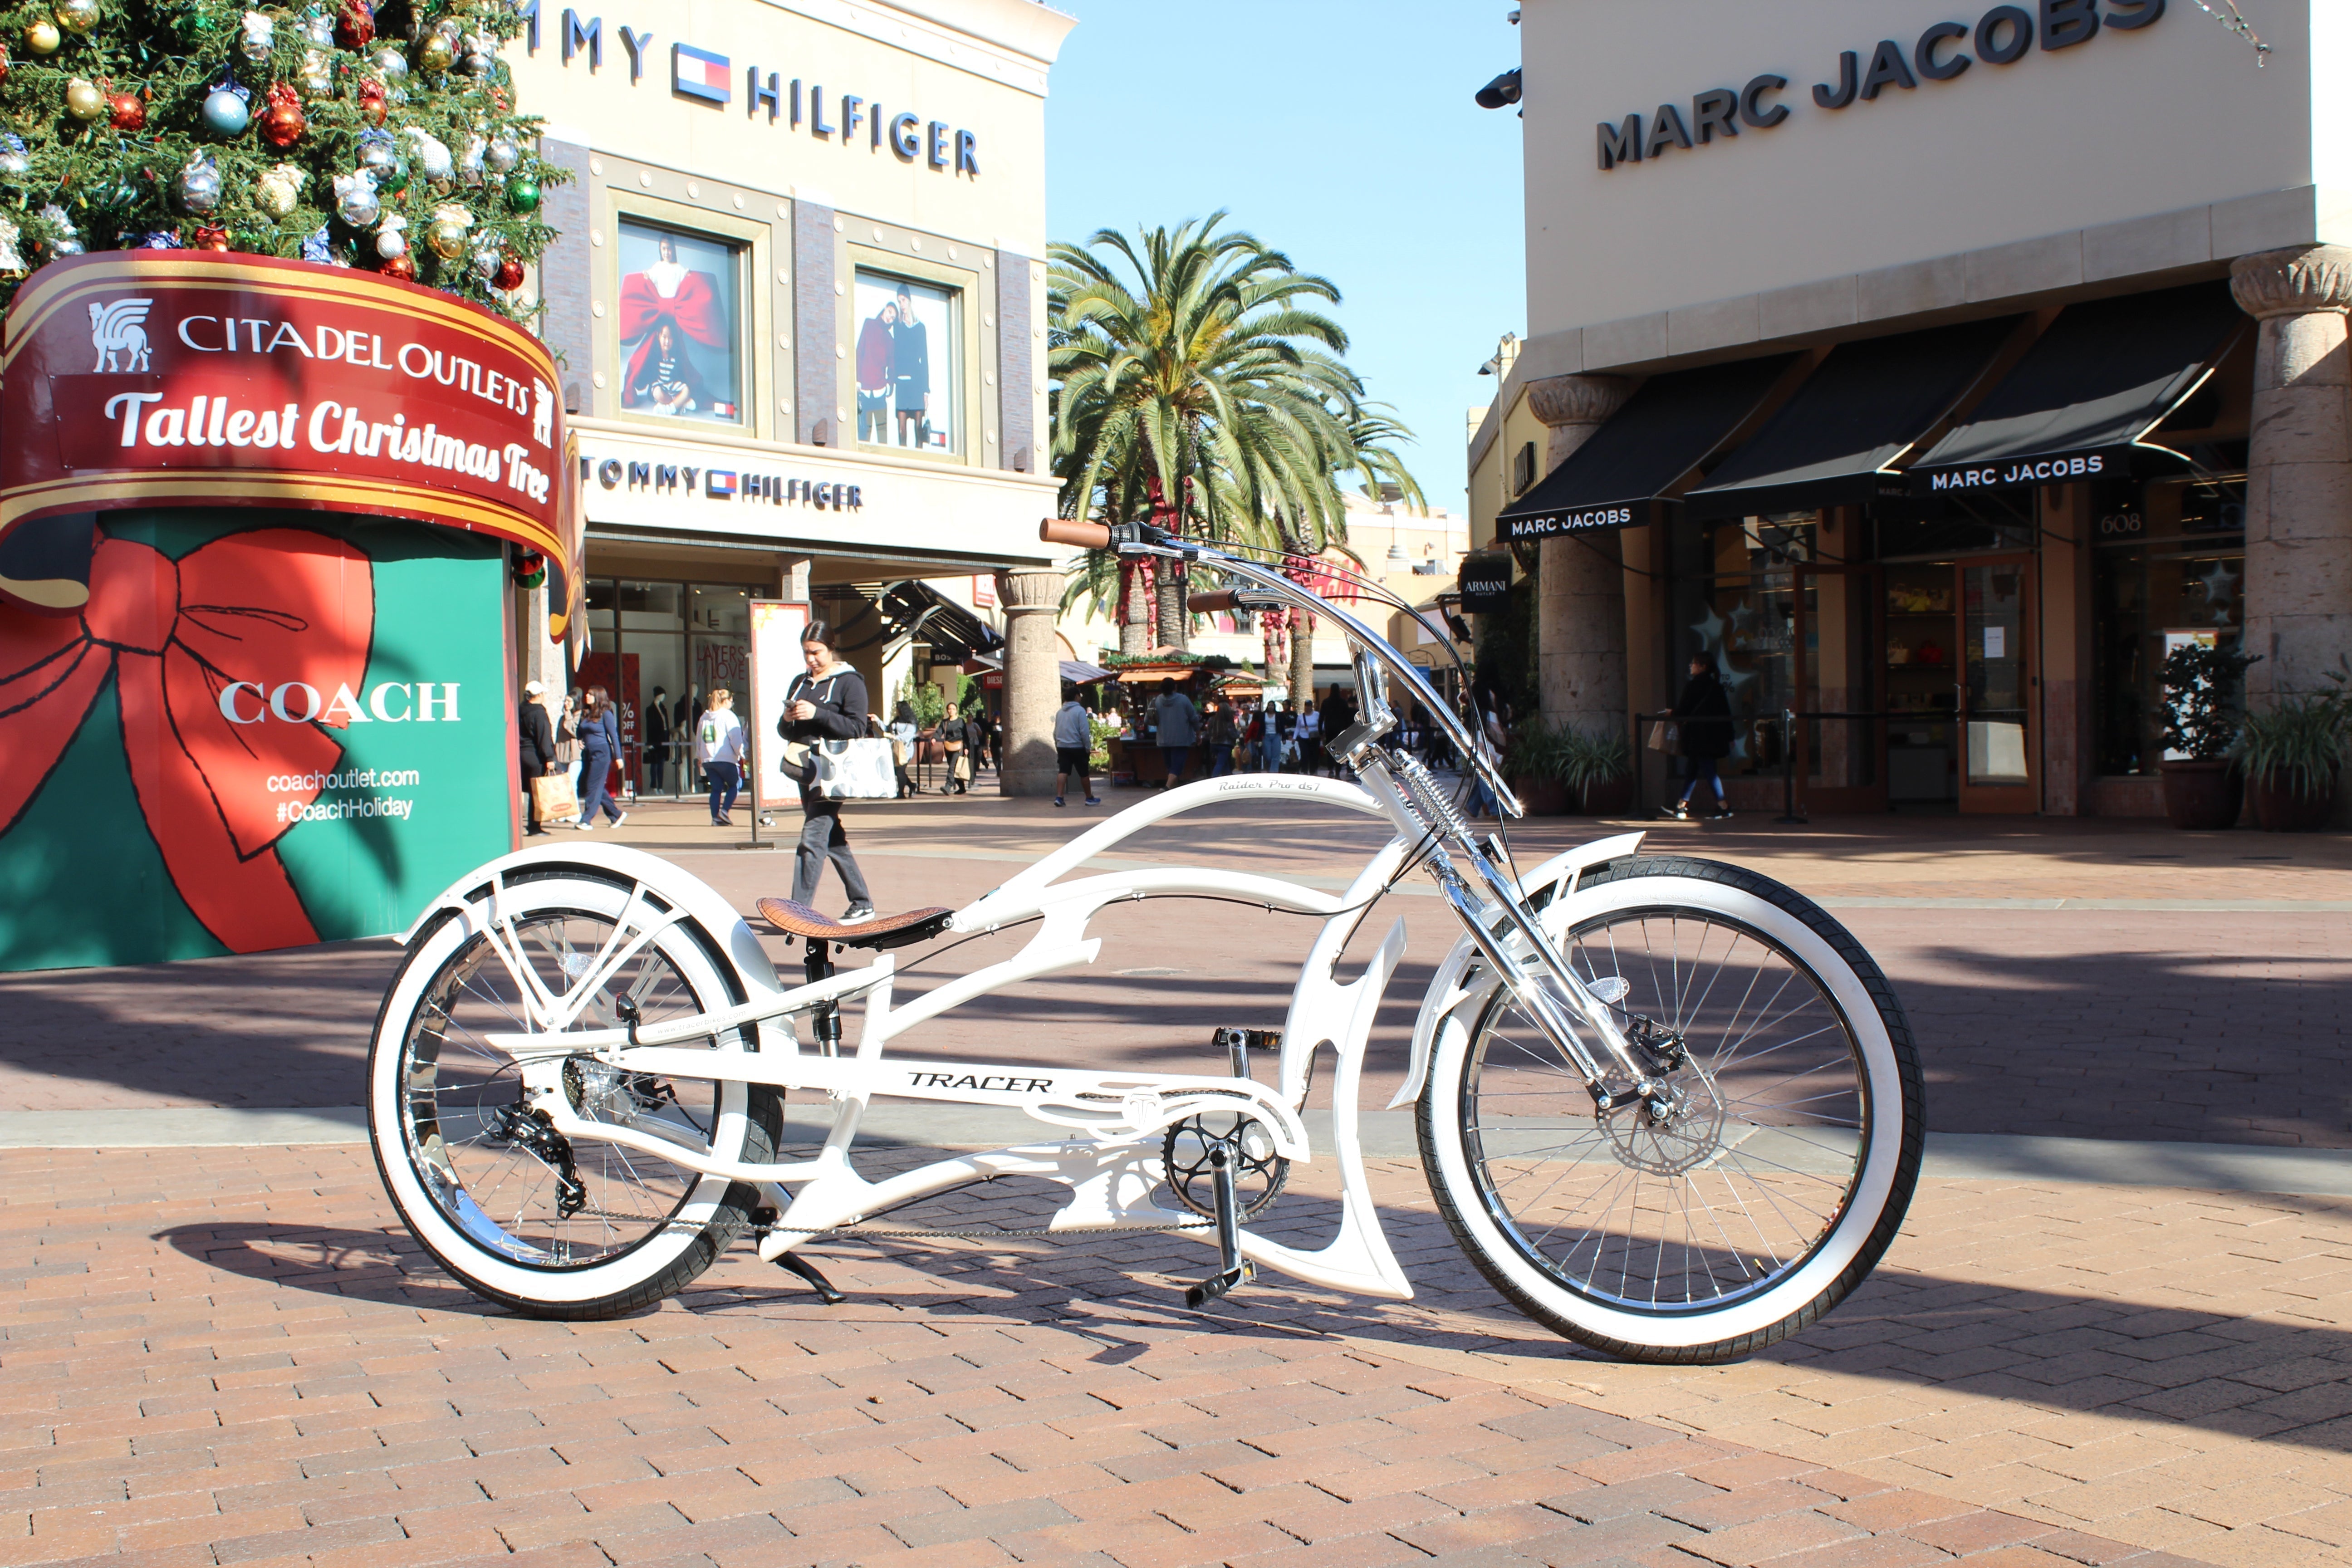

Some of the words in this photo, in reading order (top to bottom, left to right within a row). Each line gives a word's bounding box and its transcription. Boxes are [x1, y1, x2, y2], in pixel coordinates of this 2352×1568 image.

[747, 65, 980, 175] HILFIGER
[1597, 74, 1790, 171] MARC
[177, 315, 394, 371] CITADEL
[398, 343, 529, 416] OUTLETS
[104, 392, 300, 449] Tallest
[308, 400, 500, 483] Christmas
[504, 444, 549, 505] Tree
[580, 455, 701, 490] TOMMY
[742, 473, 863, 508] HILFIGER
[1932, 468, 1996, 490] MARC
[2004, 456, 2103, 482] JACOBS
[1512, 517, 1557, 536] MARC
[1562, 508, 1631, 529] JACOBS
[2101, 513, 2141, 534] 608
[1465, 581, 1506, 592] ARMANI
[697, 644, 745, 663] LAYERS
[711, 662, 745, 680] LOVE
[218, 681, 461, 724] COACH
[266, 768, 420, 792] coachoutlet.com
[1219, 781, 1263, 791] Raider
[1269, 779, 1295, 789] Pro
[276, 796, 413, 823] #CoachHoliday
[657, 1009, 746, 1034] www.tracerbikes.com
[907, 1072, 1054, 1093] TRACER
